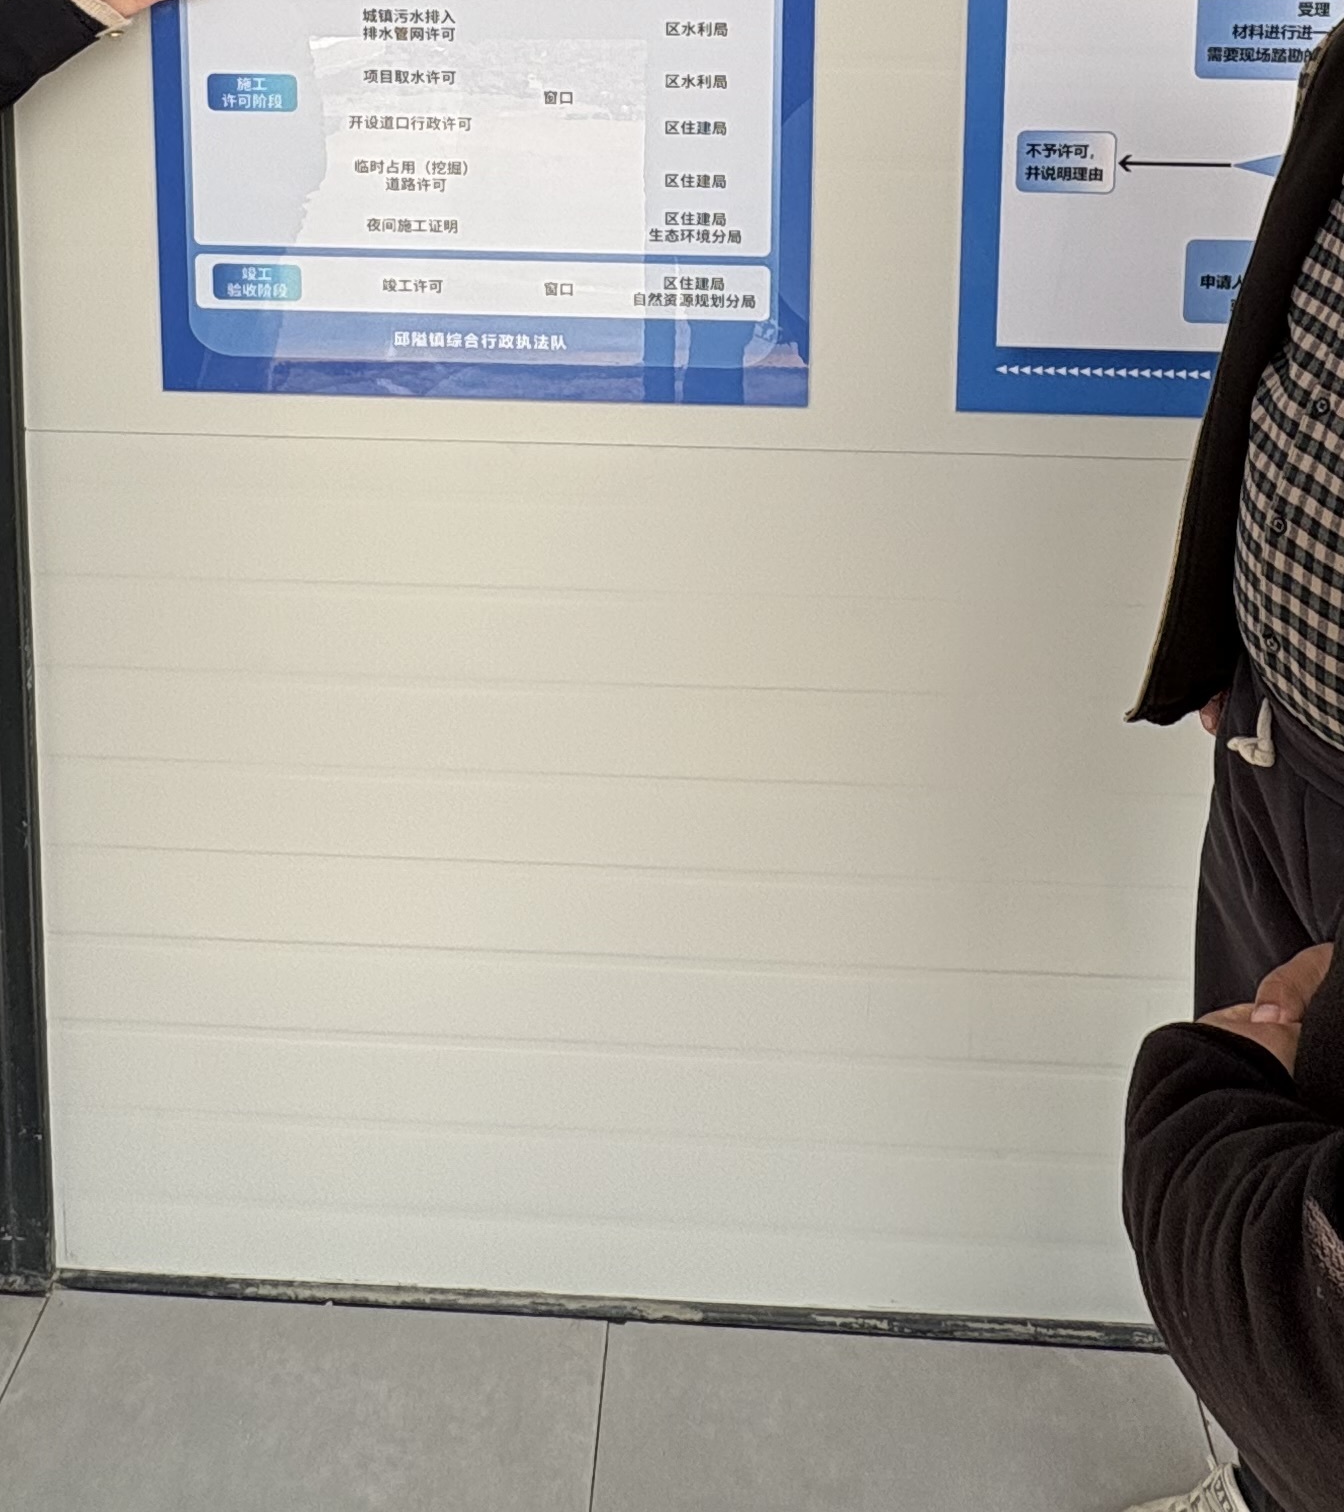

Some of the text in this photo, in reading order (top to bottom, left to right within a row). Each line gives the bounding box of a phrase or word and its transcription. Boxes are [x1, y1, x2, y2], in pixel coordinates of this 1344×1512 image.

[362, 8, 456, 24] 城镇污水排入
[1297, 1, 1331, 18] 受理
[362, 26, 456, 42] 排水管网许可
[665, 21, 729, 38] 区水利局
[236, 76, 268, 91] 施工
[363, 69, 457, 86] 项目取水许可
[665, 73, 728, 90] 区水利局
[221, 94, 283, 110] 许可阶段
[348, 115, 473, 132] 开设道口行政许可
[665, 120, 727, 137] 区住建局
[354, 159, 470, 176] 临时占用（挖掘）
[1024, 165, 1104, 184] 并说明理由
[384, 178, 447, 193] 道路许可
[665, 173, 727, 189] 区住建局
[366, 218, 459, 235] 夜间施工证明
[665, 211, 727, 227] 区住建局
[648, 228, 743, 245] 生态环境分局
[241, 267, 272, 282] 竣工
[226, 283, 288, 299] 验收阶段
[382, 278, 444, 294] 竣工许可
[544, 282, 574, 297] 窗口
[663, 276, 725, 292] 区住建局
[633, 292, 756, 309] 自然资源规划分局
[393, 330, 567, 351] 邱隘镇综合行政执法队
